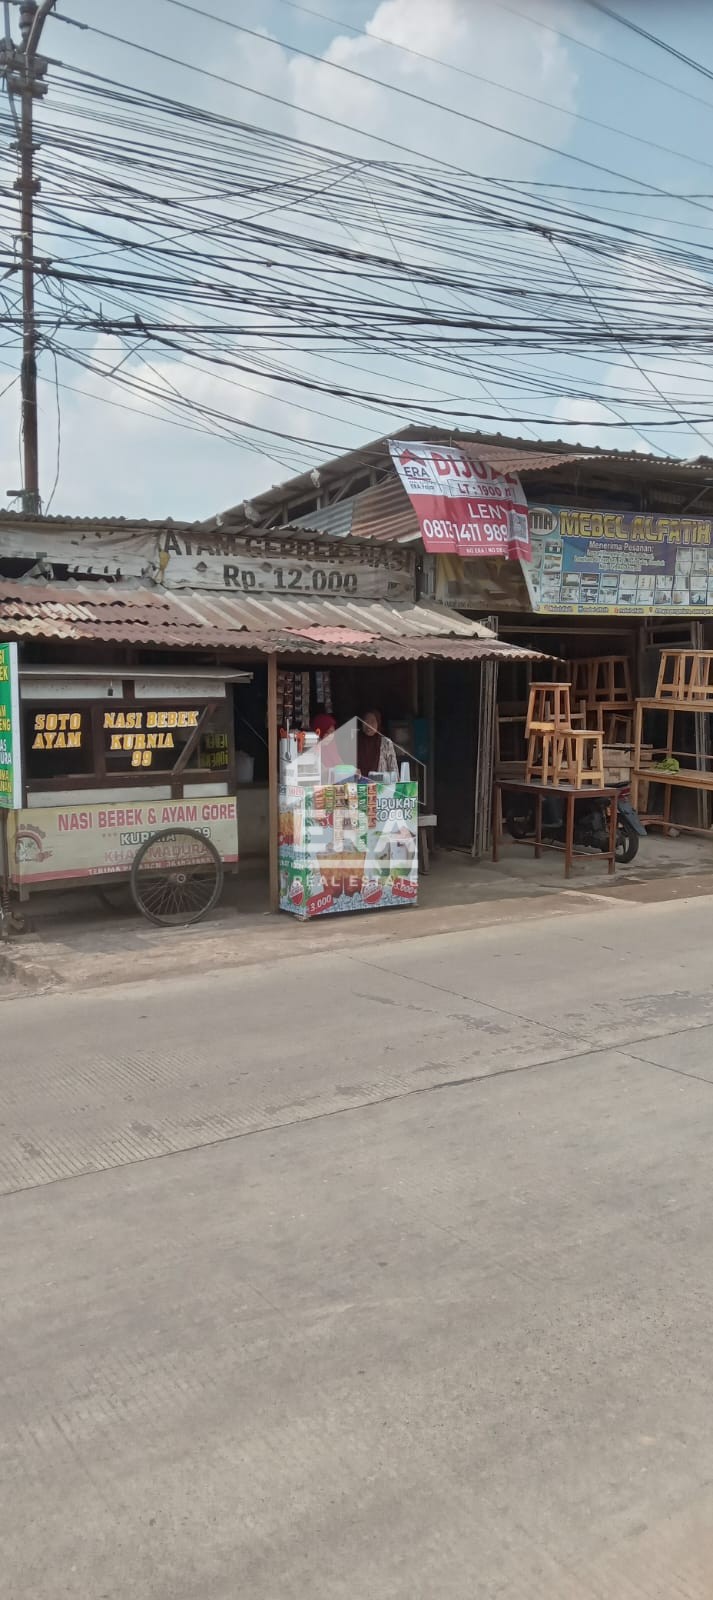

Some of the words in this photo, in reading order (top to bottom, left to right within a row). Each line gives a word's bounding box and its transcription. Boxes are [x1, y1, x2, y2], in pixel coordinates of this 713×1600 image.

[403, 466, 431, 478] ERA
[457, 483, 470, 494] LT
[480, 485, 502, 496] 1900
[559, 511, 630, 540] MEBEL
[630, 515, 712, 546] ALFATIH
[588, 541, 623, 552] Menerima
[223, 564, 264, 589] Rp.
[274, 567, 358, 594] 12.000
[34, 713, 81, 731] SOTO
[103, 712, 142, 728] NASI
[146, 711, 199, 728] BEBEK
[32, 731, 81, 749] AYAM
[110, 732, 174, 750] KURNIA
[131, 750, 152, 767] 99
[58, 812, 93, 831] NASI
[99, 808, 143, 828] BEBEK
[147, 811, 157, 825] &
[162, 806, 197, 823] AYAM
[202, 803, 235, 821] GORE
[104, 848, 138, 863] KHA
[311, 894, 332, 911] 3.000
